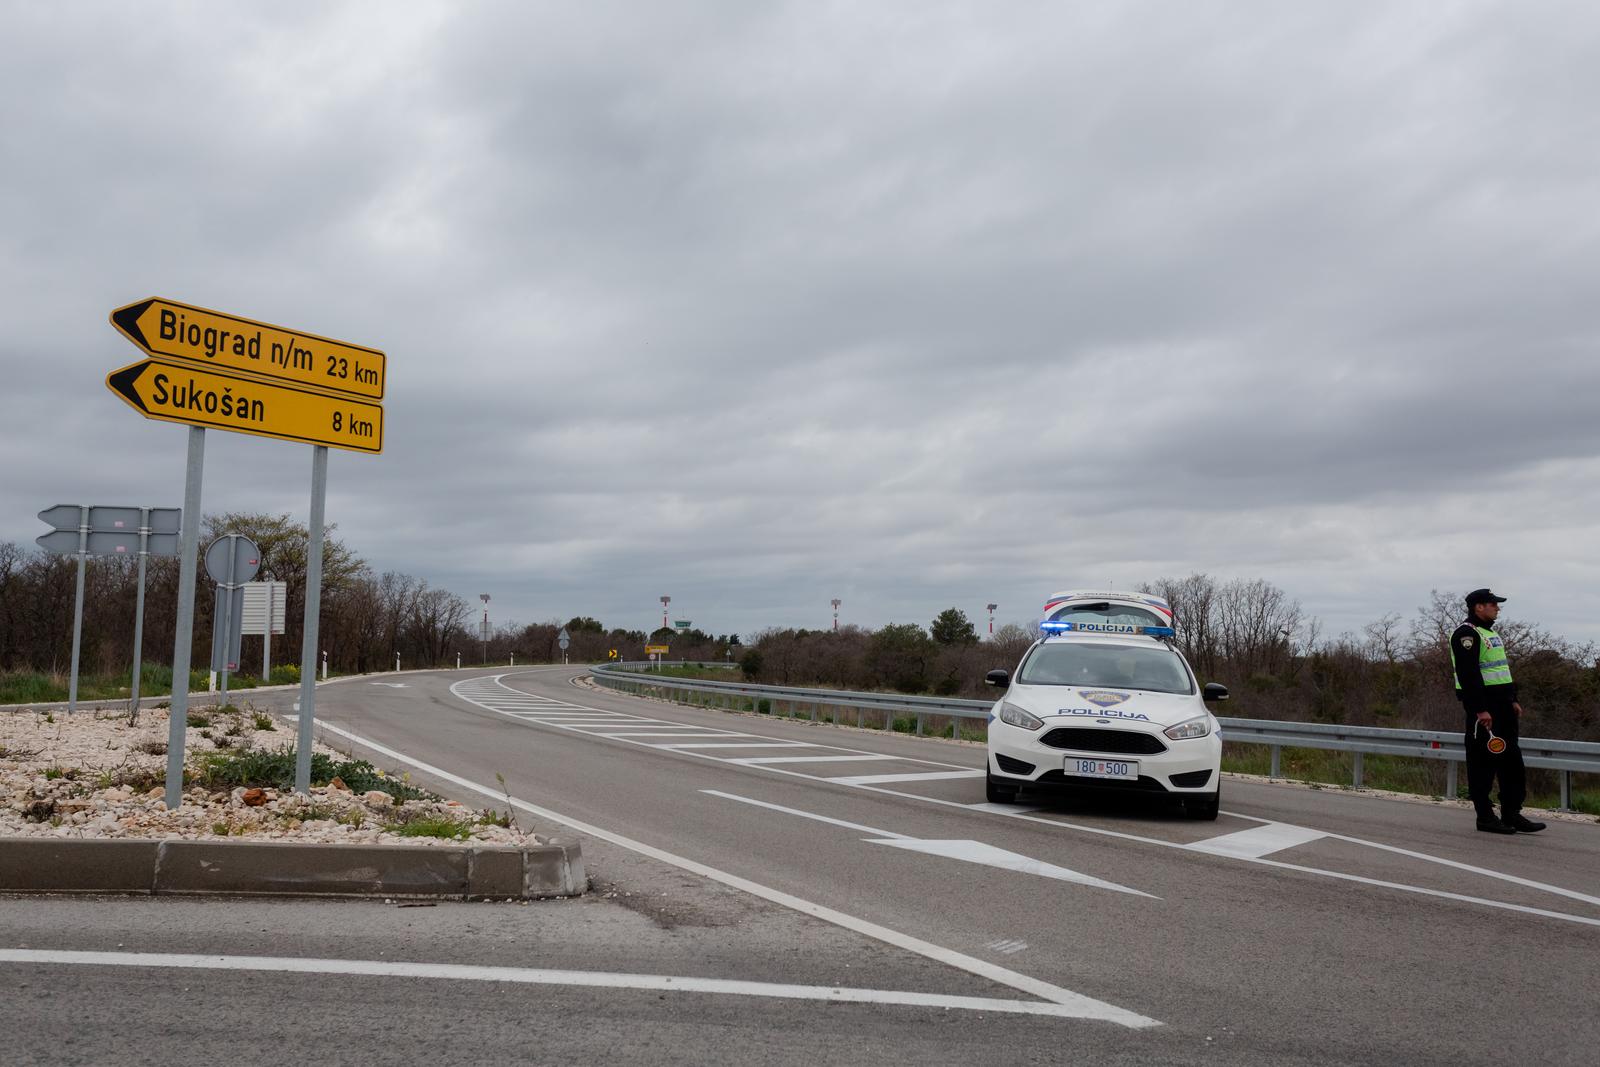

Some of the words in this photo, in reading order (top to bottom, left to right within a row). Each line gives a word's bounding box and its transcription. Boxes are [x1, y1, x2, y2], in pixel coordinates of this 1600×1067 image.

[159, 310, 261, 358] Biograd
[271, 338, 313, 371] n/m
[326, 355, 348, 379] 23
[354, 360, 378, 386] km
[152, 373, 265, 422] Sukošan
[332, 411, 342, 432] 8
[349, 414, 373, 438] km
[1079, 623, 1134, 633] POLICIJA
[1058, 708, 1150, 721] POLICIJA
[1075, 760, 1096, 774] 180
[1105, 763, 1128, 776] 500
